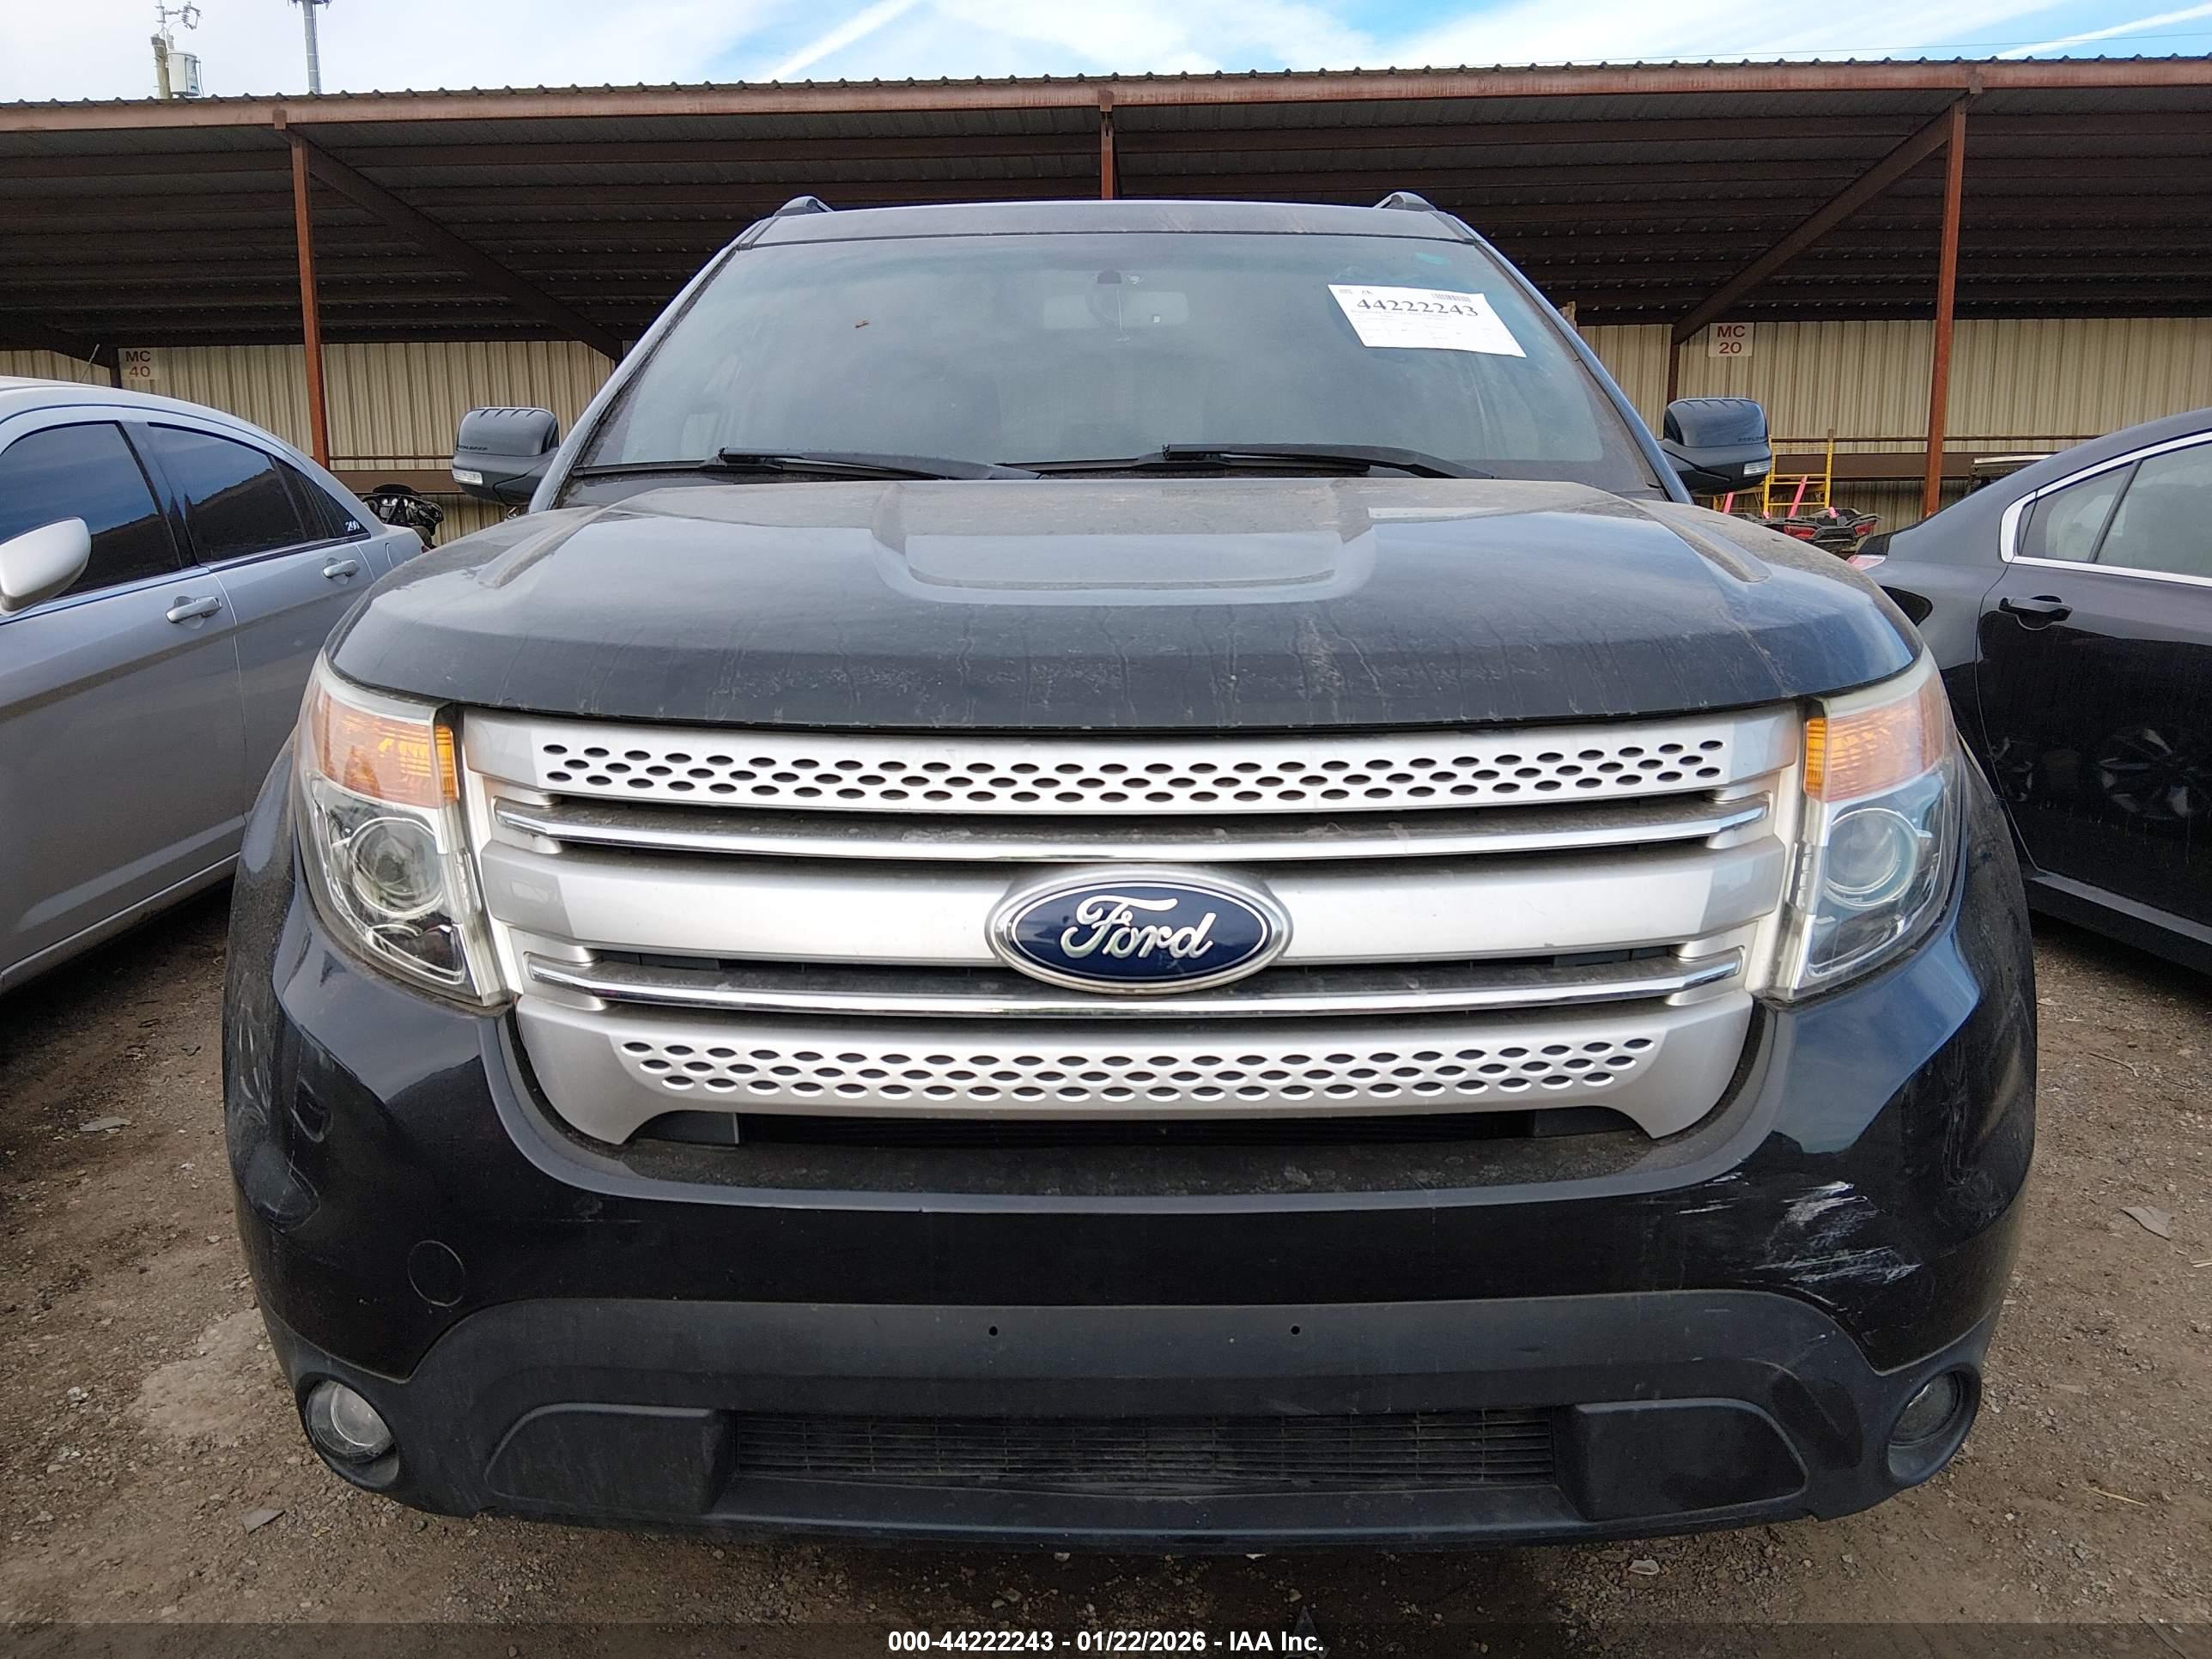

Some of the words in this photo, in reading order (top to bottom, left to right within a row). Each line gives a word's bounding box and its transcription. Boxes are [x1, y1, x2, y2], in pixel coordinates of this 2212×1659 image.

[1357, 298, 1479, 317] 44222243
[1717, 325, 1746, 338] MC
[1718, 342, 1742, 355] 20
[125, 350, 151, 362] MC
[129, 366, 151, 378] 40
[1060, 894, 1218, 959] Ford
